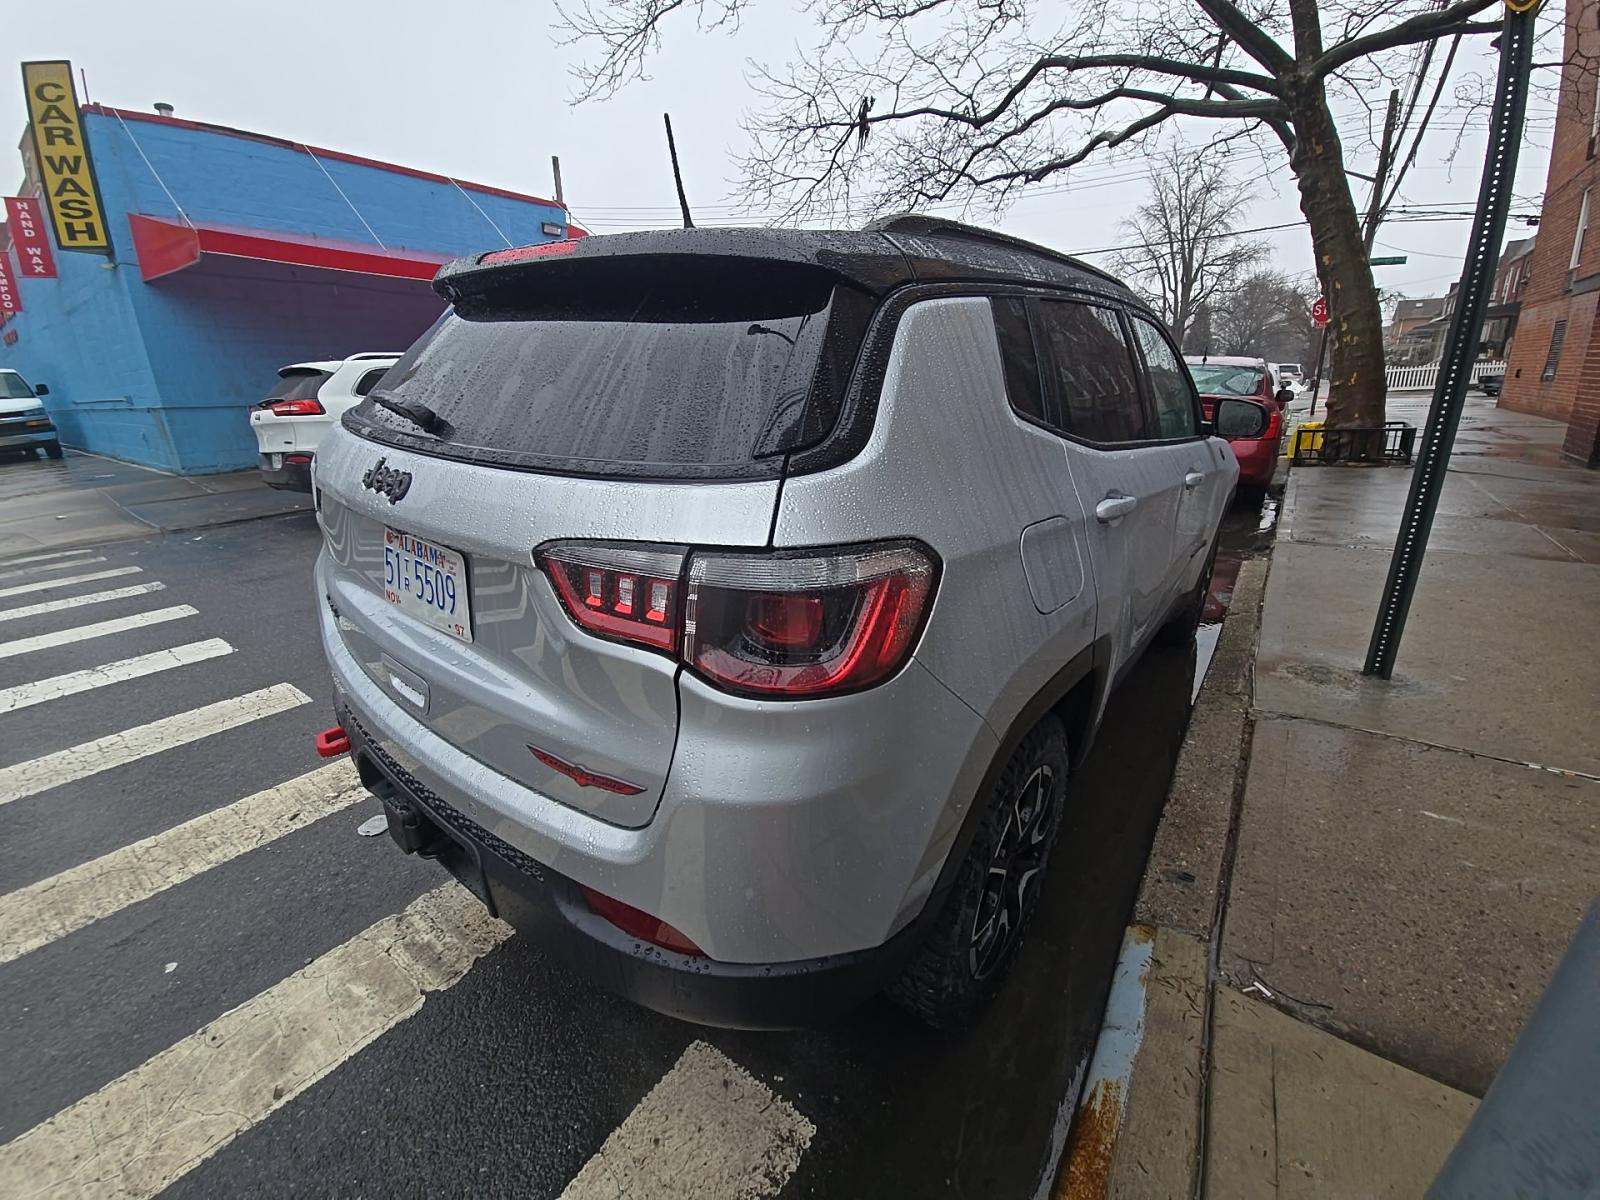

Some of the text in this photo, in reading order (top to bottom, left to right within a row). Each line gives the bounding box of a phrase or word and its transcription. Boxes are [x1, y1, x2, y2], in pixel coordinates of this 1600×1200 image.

[35, 82, 98, 241] CAR WASH
[16, 202, 45, 273] HAND WAX
[362, 457, 412, 505] Jeep
[385, 546, 400, 590] 51
[415, 560, 455, 614] 5509
[399, 534, 445, 568] ALABAMA
